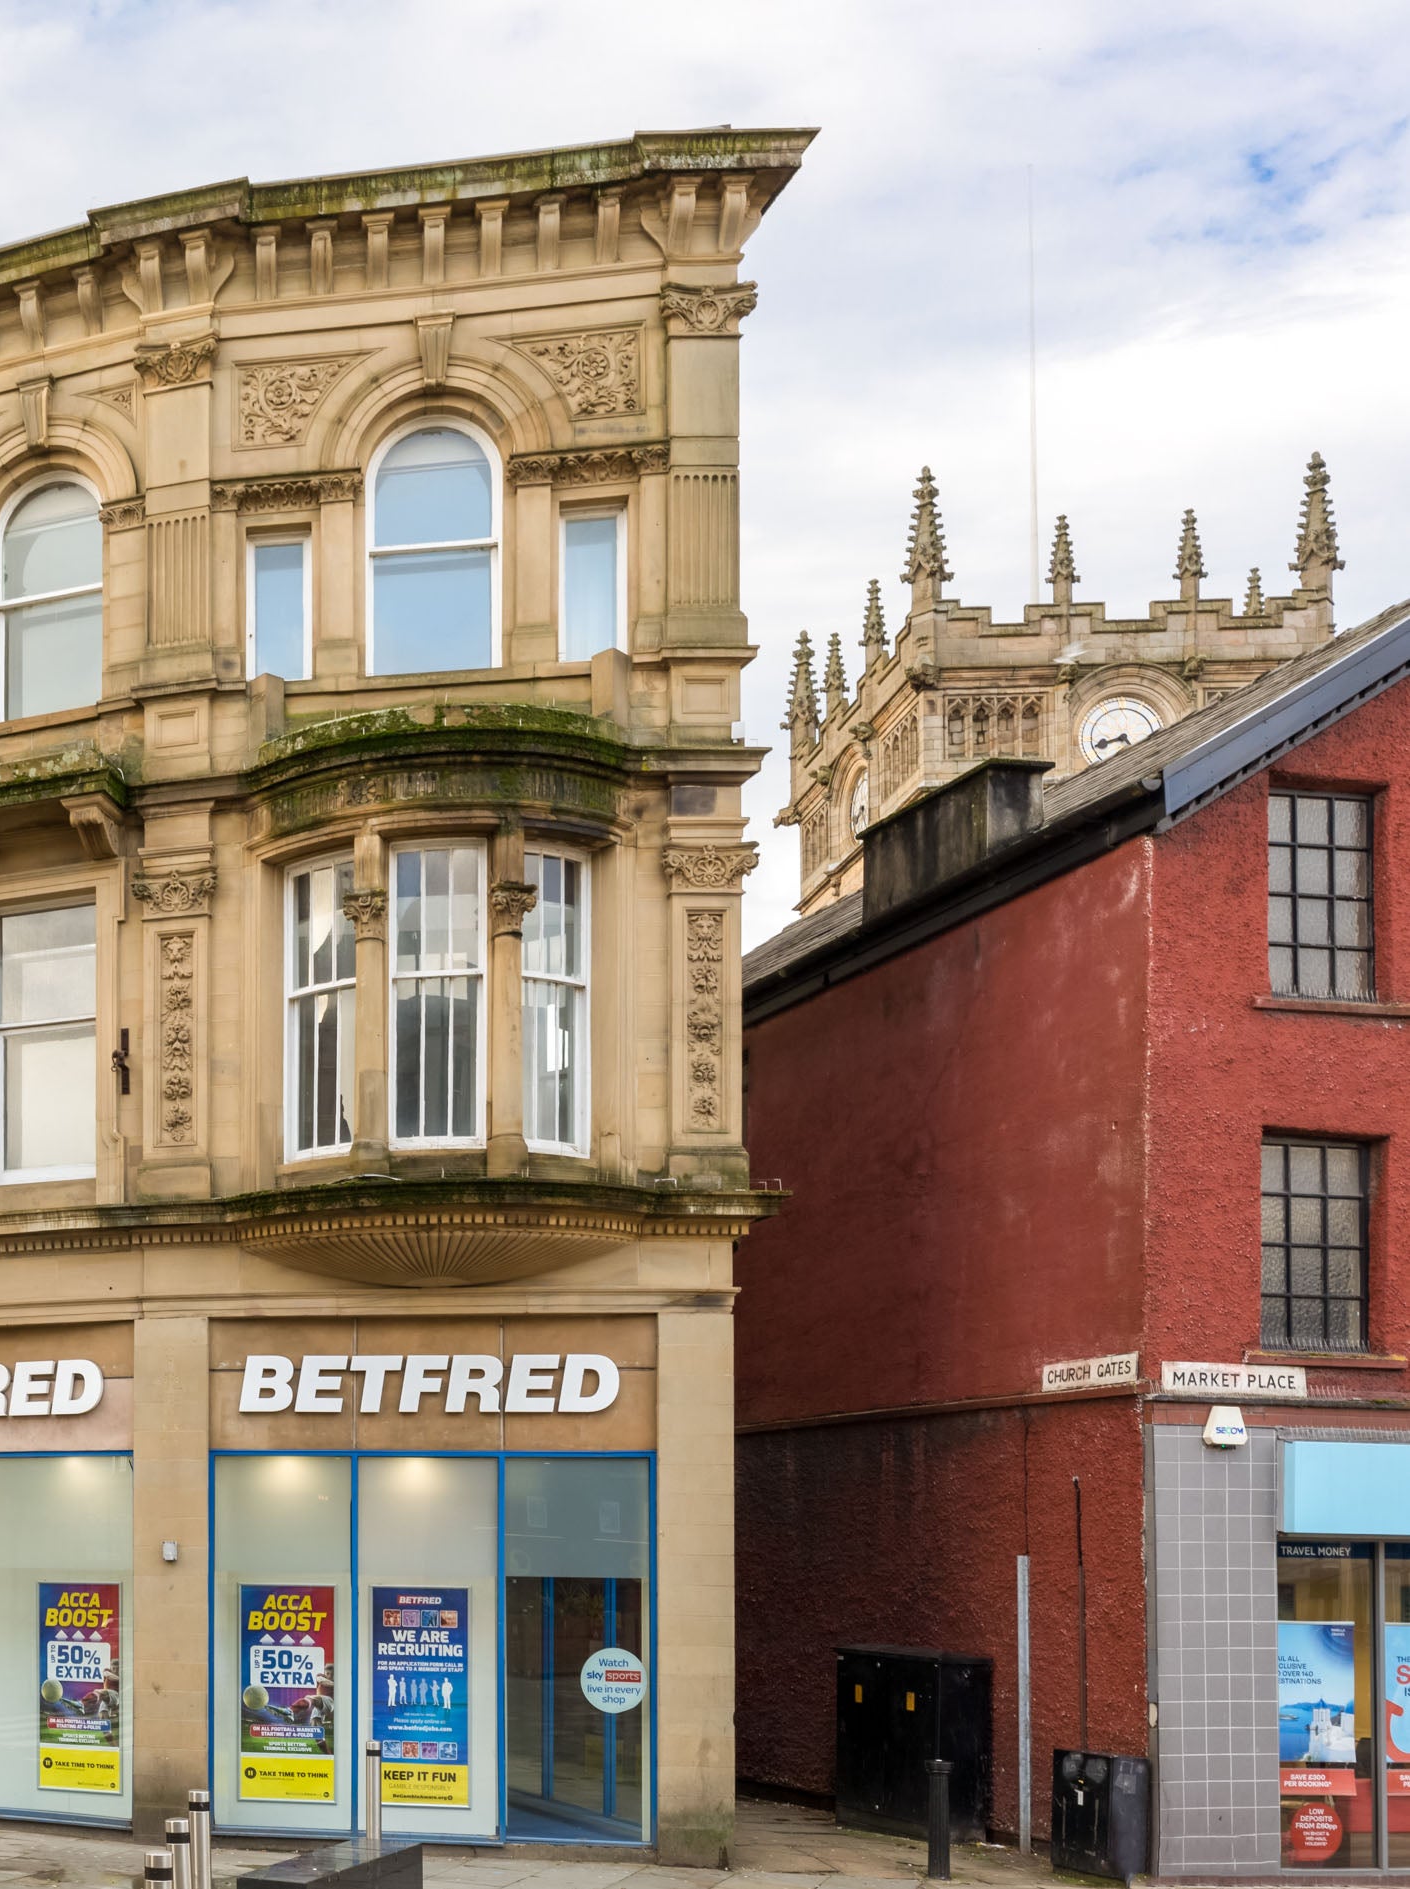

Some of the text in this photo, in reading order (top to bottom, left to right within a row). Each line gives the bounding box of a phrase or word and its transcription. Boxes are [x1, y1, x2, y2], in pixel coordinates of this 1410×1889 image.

[1047, 1360, 1132, 1384] CHURCH GATES
[239, 1353, 620, 1414] BETFRED
[1173, 1372, 1296, 1390] MARKET PLACE
[1281, 1546, 1351, 1557] TRAVEL MONEY
[58, 1592, 100, 1608] ACCA
[263, 1594, 313, 1611] ACCA
[398, 1596, 442, 1605] BETFRED
[45, 1608, 113, 1628] BOOST
[248, 1611, 327, 1632] BOOST
[392, 1630, 449, 1643] WE ARE
[51, 1645, 56, 1653] TO
[58, 1645, 101, 1665] 50%
[255, 1649, 260, 1658] TO
[378, 1643, 463, 1657] RECRUITING
[51, 1655, 56, 1663] UP
[255, 1660, 260, 1668] UP
[262, 1650, 313, 1670] 50%
[599, 1659, 629, 1668] Watch
[56, 1666, 102, 1680] EXTRA
[260, 1671, 315, 1685] EXTRA
[587, 1671, 640, 1681] sky sports
[587, 1685, 641, 1696] live in every
[602, 1696, 626, 1705] shop
[384, 1770, 457, 1782] KEEP IT FUN
